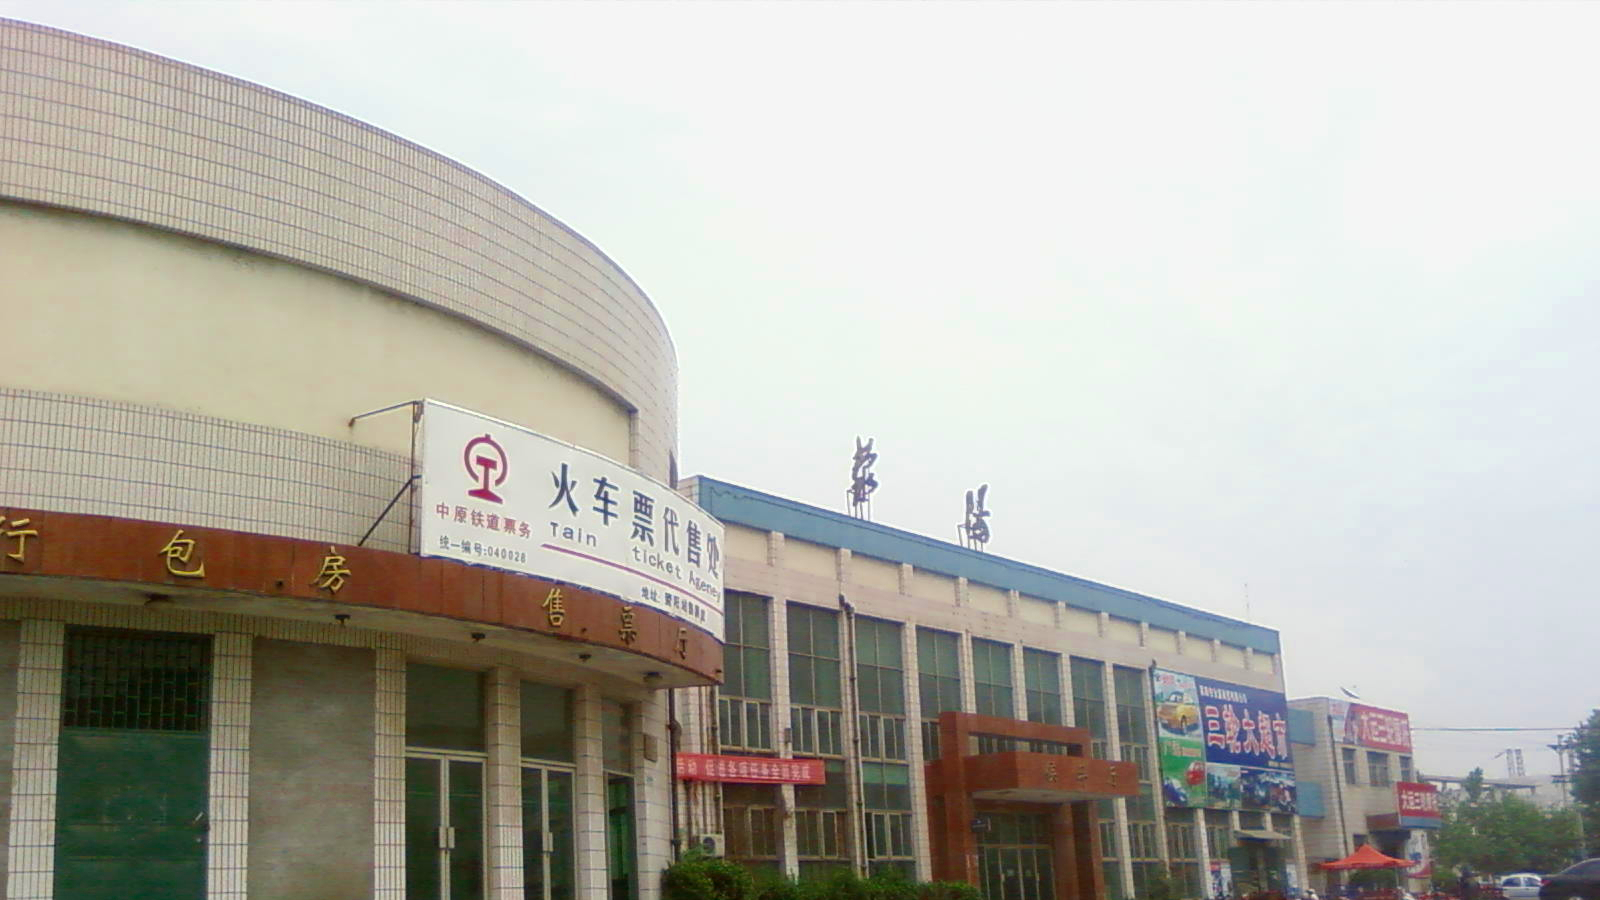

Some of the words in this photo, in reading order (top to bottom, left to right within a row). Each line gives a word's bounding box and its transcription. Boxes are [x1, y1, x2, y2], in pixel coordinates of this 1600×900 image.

[0, 515, 352, 594] 行包房
[436, 502, 532, 539] 中原铁道票务
[548, 462, 720, 580] 火车票代售处
[550, 521, 598, 547] Tain
[632, 546, 682, 580] ticket
[542, 587, 688, 660] 售票厅
